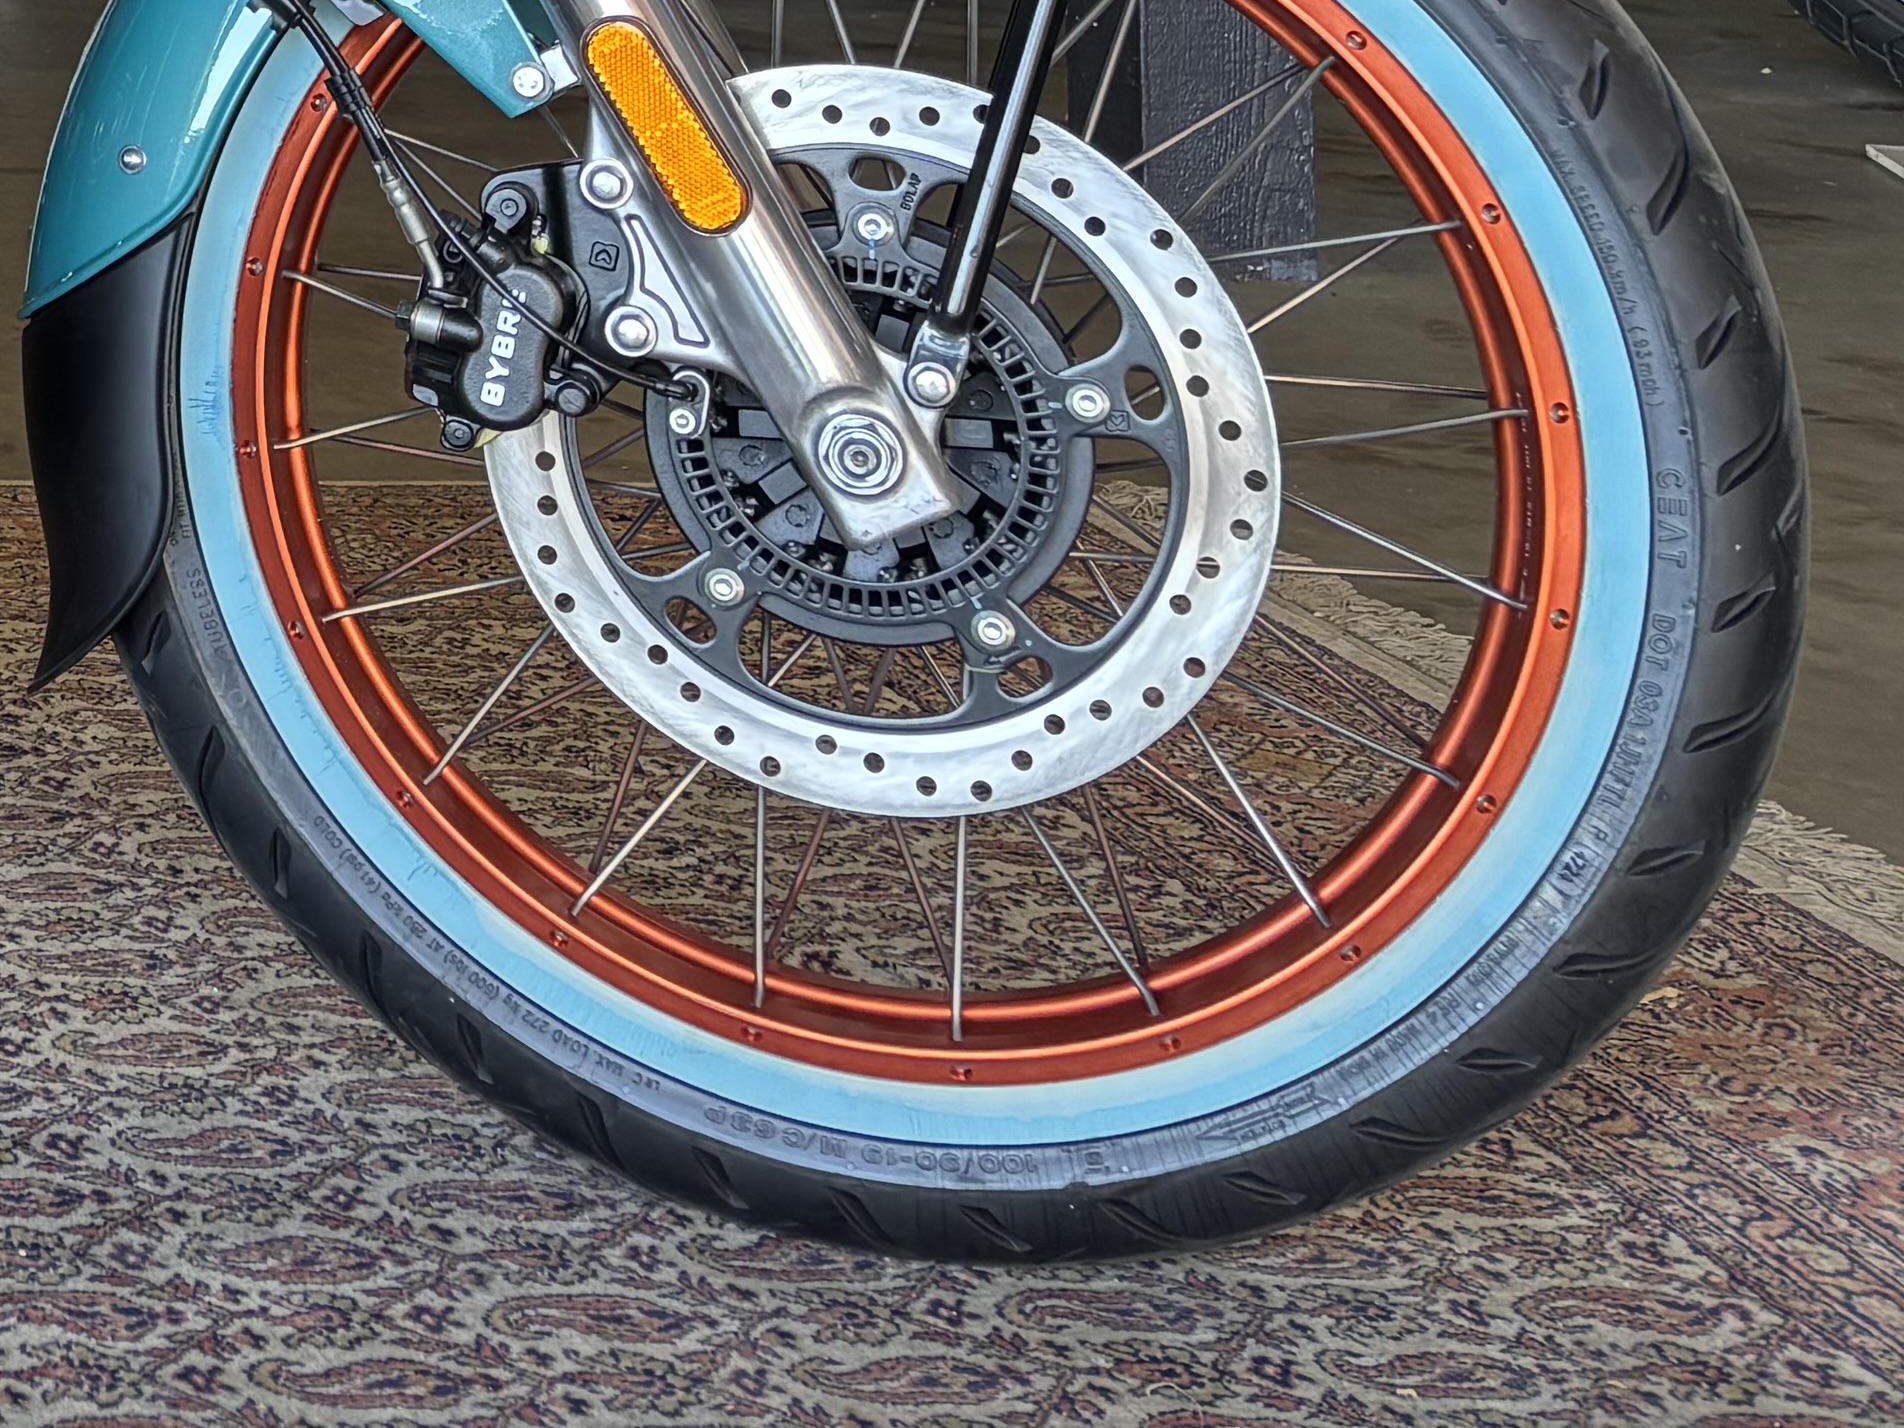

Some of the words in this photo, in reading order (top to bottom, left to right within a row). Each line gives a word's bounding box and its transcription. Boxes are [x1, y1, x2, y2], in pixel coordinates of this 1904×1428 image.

[1653, 467, 1688, 569] CEAT
[1643, 612, 1677, 672] DOT
[309, 811, 345, 850] COLD
[424, 935, 446, 955] AT
[518, 1007, 551, 1033] 272
[548, 1026, 592, 1059] LOAD
[858, 1142, 1037, 1175] 100/90-19
